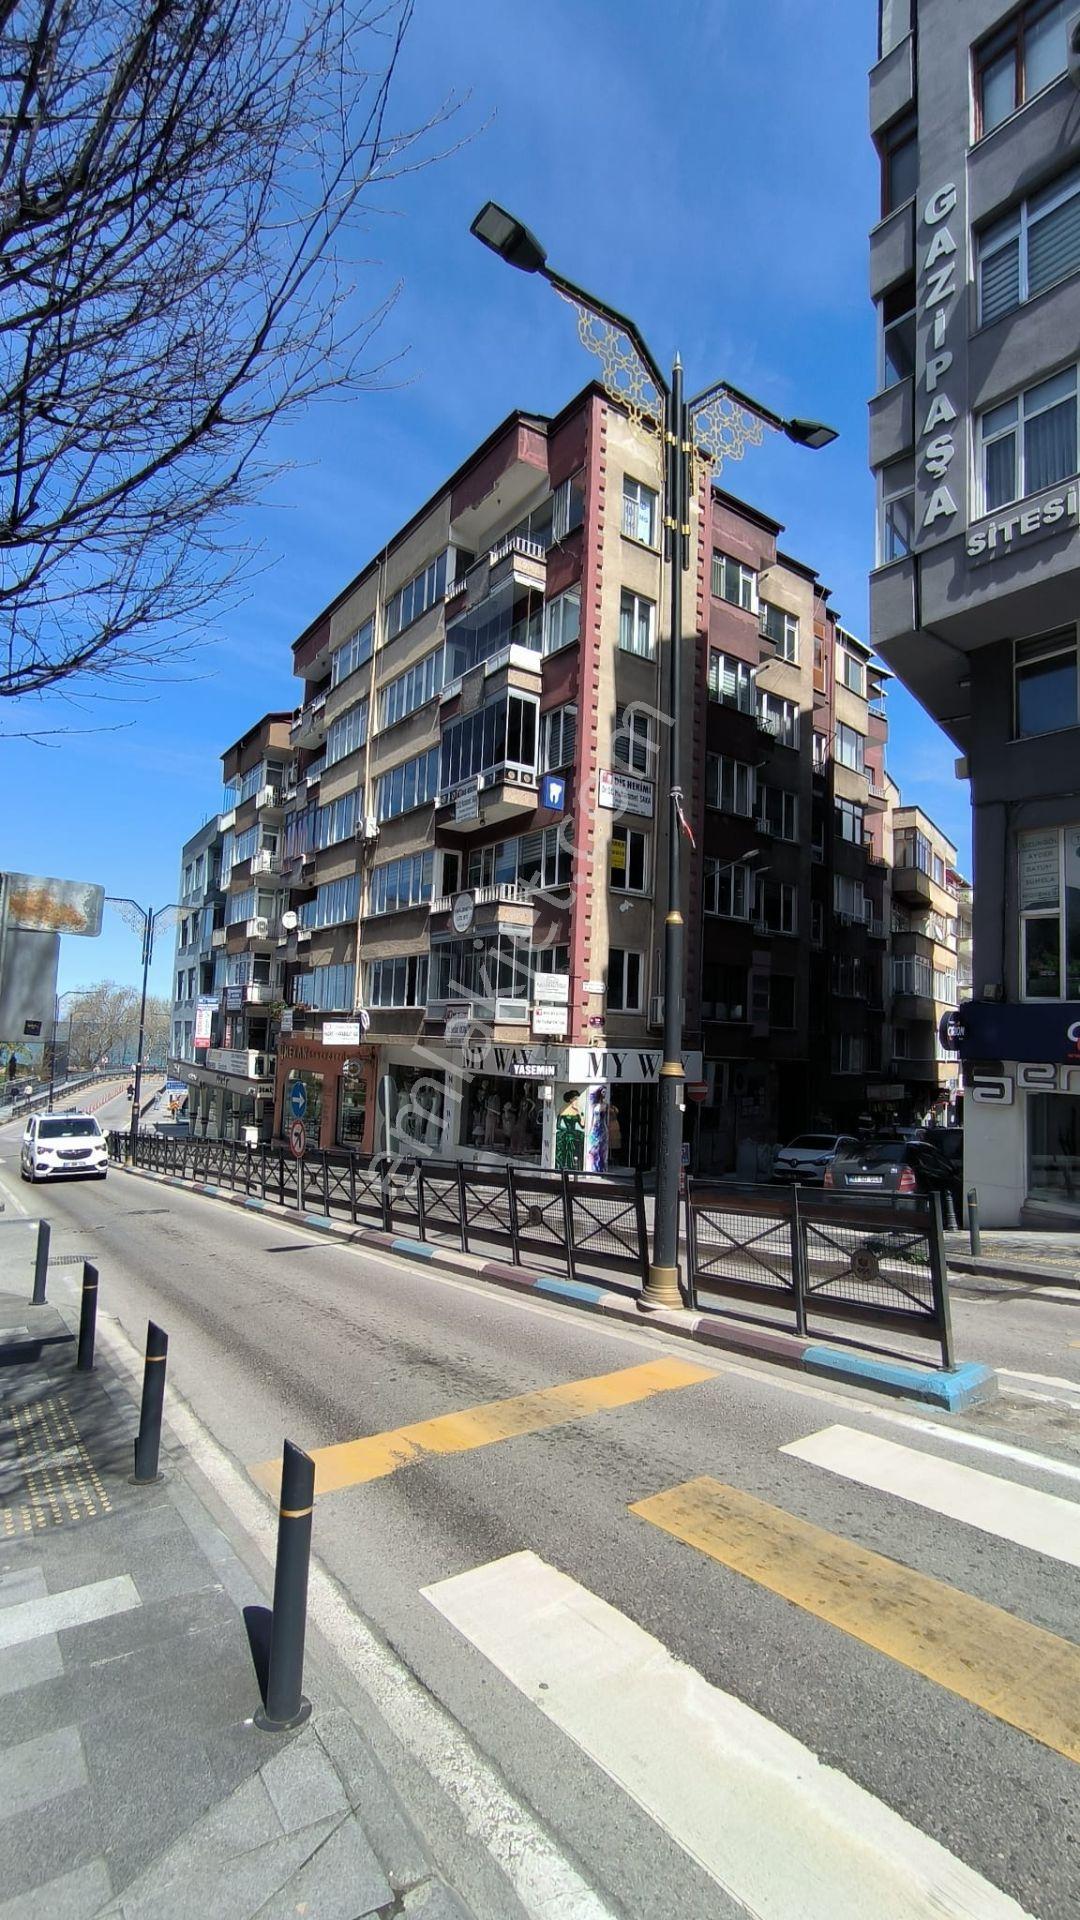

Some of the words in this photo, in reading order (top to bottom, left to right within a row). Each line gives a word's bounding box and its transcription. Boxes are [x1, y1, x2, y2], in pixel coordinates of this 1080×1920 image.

[923, 182, 957, 527] GAZİPAŞA
[967, 486, 1077, 556] SİTESİ
[463, 1046, 485, 1070] MY
[494, 1047, 532, 1073] WAY
[586, 1052, 628, 1079] MY
